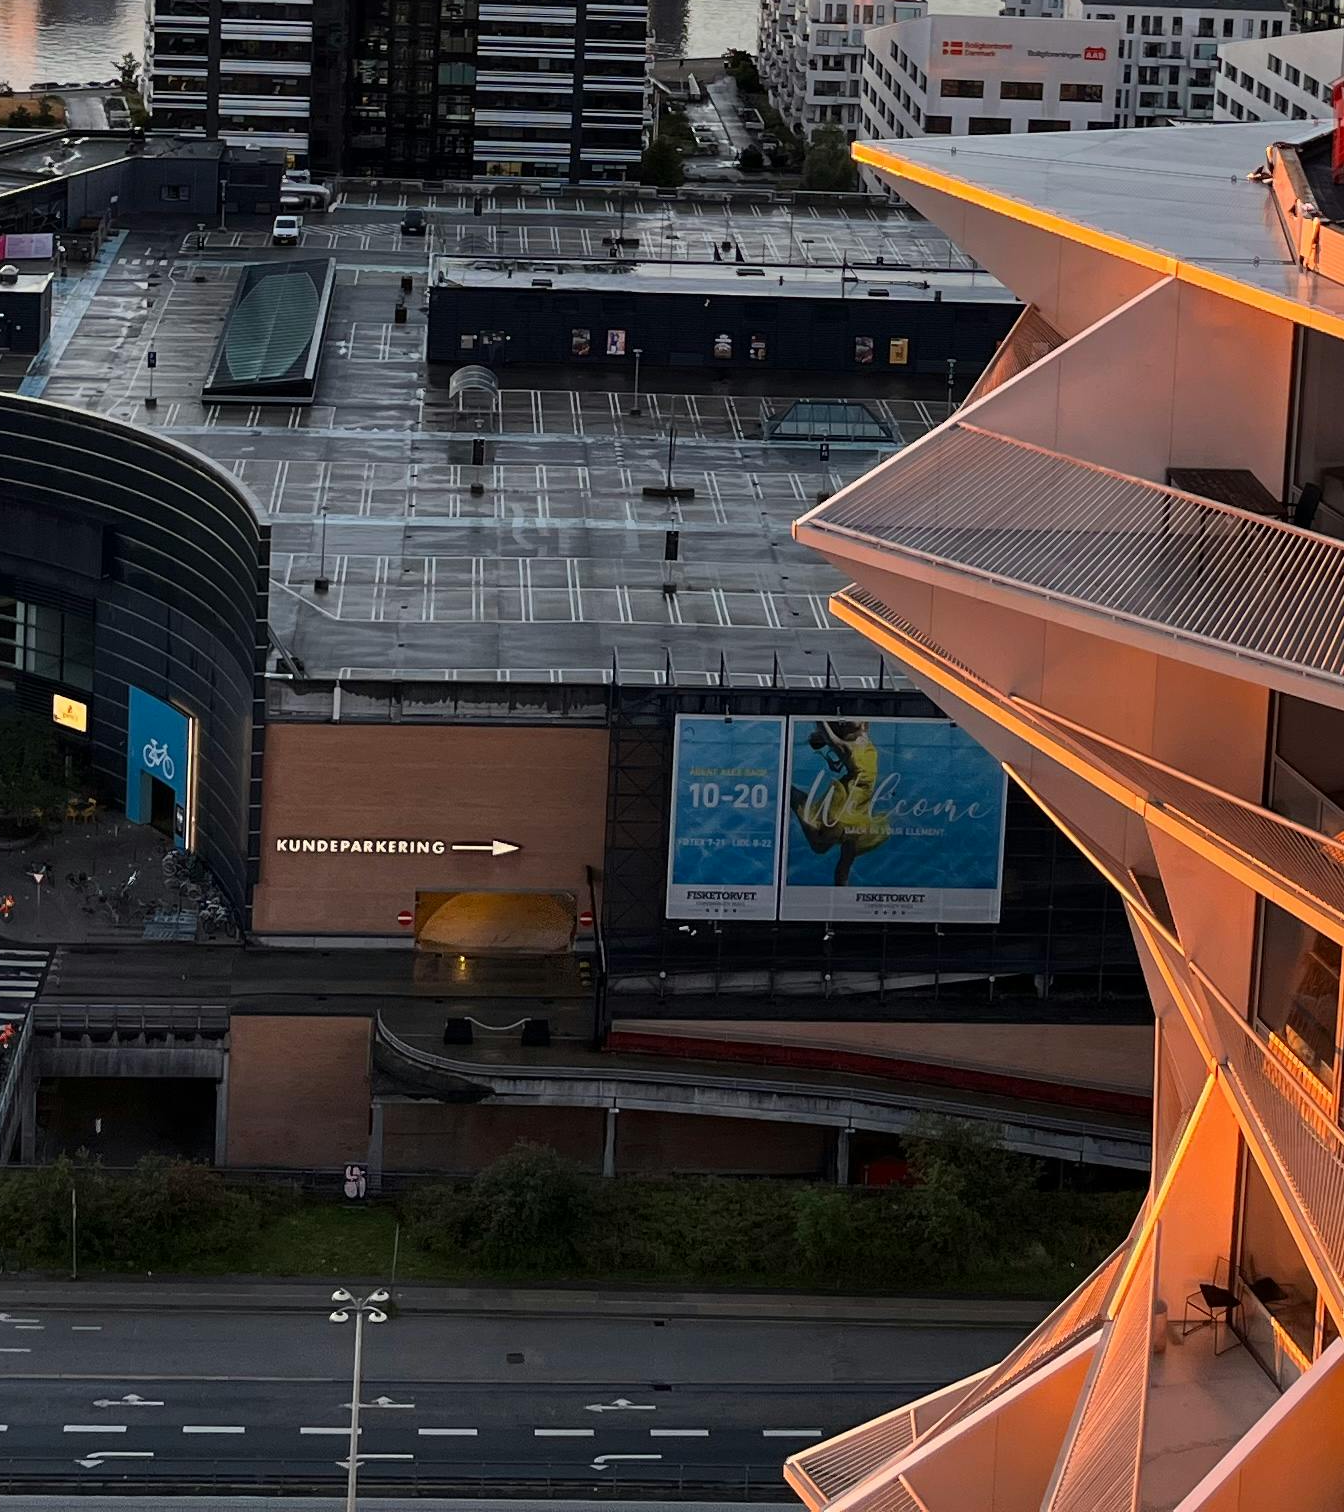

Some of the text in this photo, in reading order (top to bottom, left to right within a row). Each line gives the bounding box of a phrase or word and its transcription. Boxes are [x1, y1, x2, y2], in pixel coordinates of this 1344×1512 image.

[689, 782, 769, 809] 10-20
[803, 769, 994, 829] Welcome
[276, 838, 446, 855] KUNDEPARKERING
[686, 890, 757, 901] FISKETORVET
[855, 892, 926, 903] FISKETORVET
